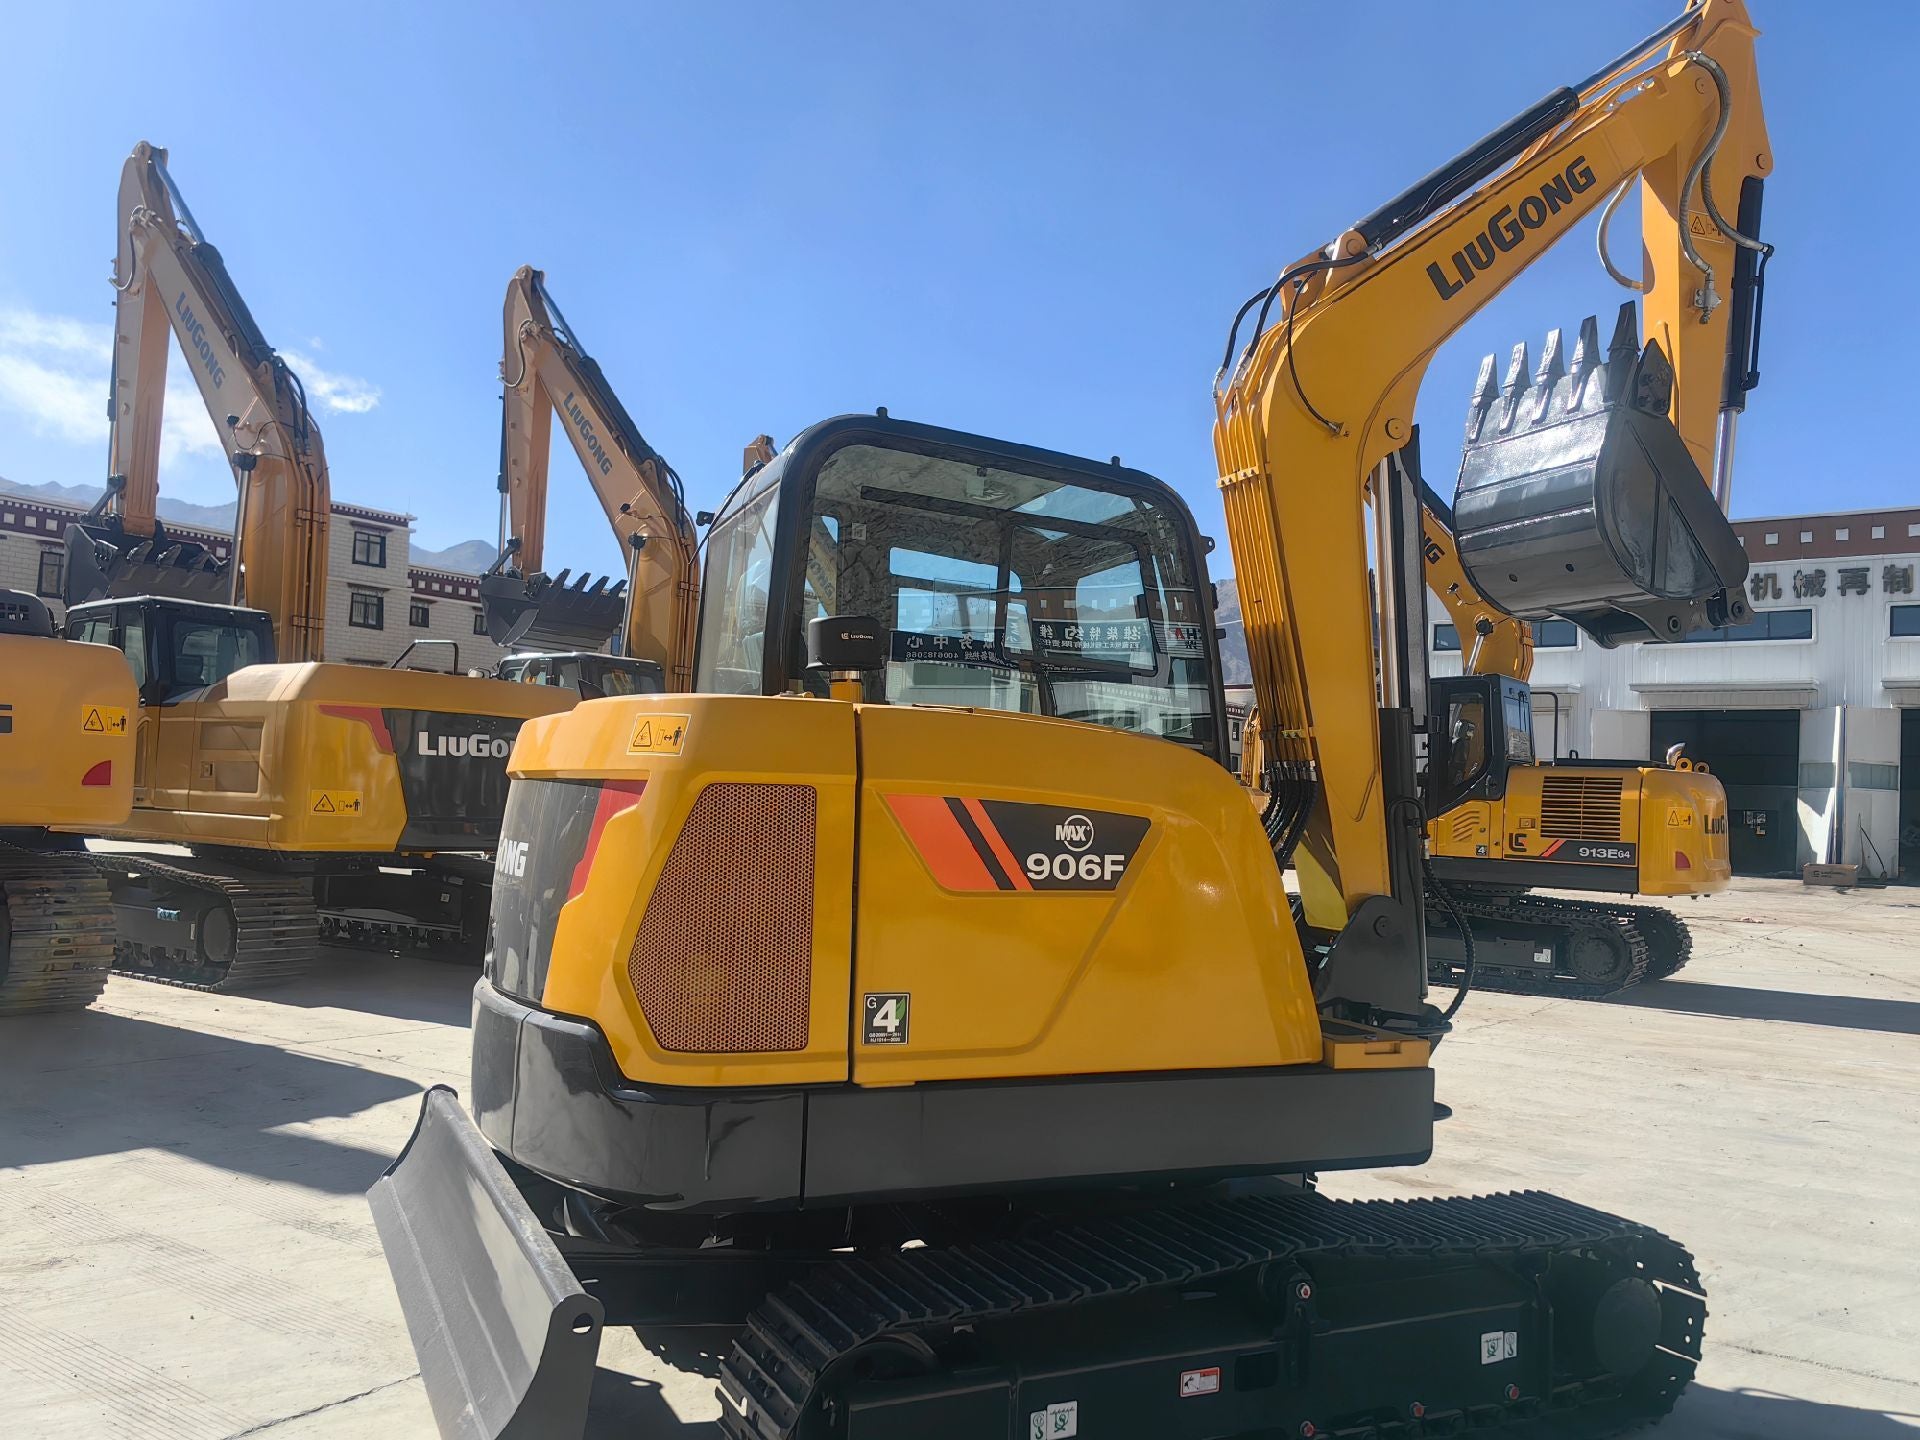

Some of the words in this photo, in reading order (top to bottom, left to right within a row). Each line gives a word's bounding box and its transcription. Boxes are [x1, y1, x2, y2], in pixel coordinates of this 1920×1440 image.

[1750, 564, 1914, 602] 机械再制
[418, 731, 517, 758] LIUGO
[1026, 853, 1125, 881] 906F
